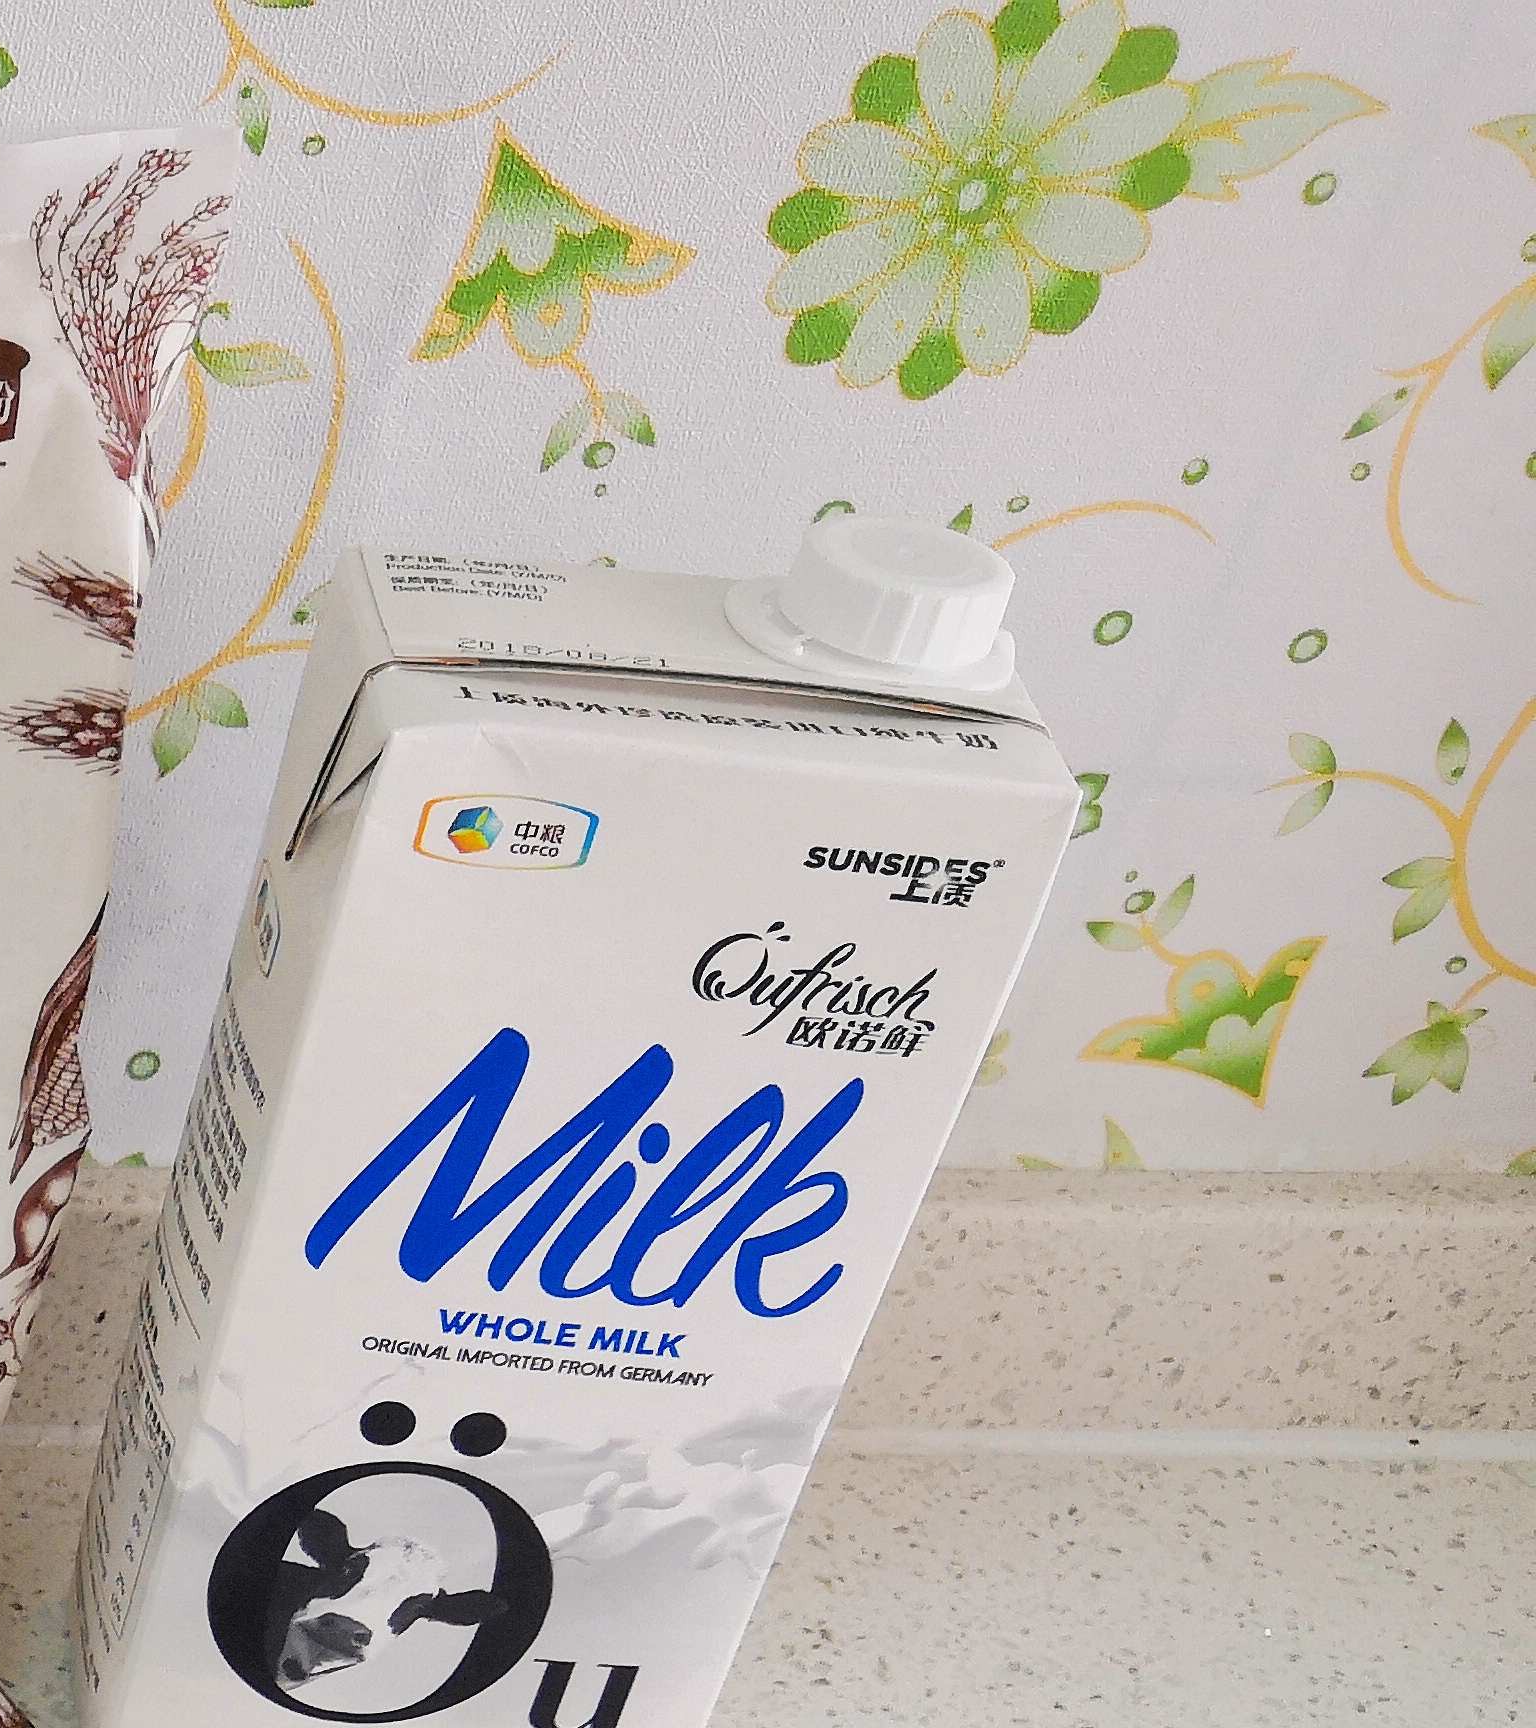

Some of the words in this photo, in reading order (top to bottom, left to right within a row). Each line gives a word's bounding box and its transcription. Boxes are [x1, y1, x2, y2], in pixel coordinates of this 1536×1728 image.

[509, 842, 560, 858] COFCO
[514, 820, 566, 844] 中粮
[803, 845, 992, 887] SUNSIDES
[889, 877, 976, 908] 上质
[785, 1015, 936, 1058] 欧诺鲜
[304, 1027, 865, 1318] Milk
[439, 1308, 578, 1351] WHOLE
[588, 1326, 688, 1359] MILK
[361, 1335, 451, 1362] ORIGINAL
[455, 1350, 554, 1374] IMPORTED
[557, 1358, 615, 1379] FROM
[618, 1365, 715, 1388] GERMANY
